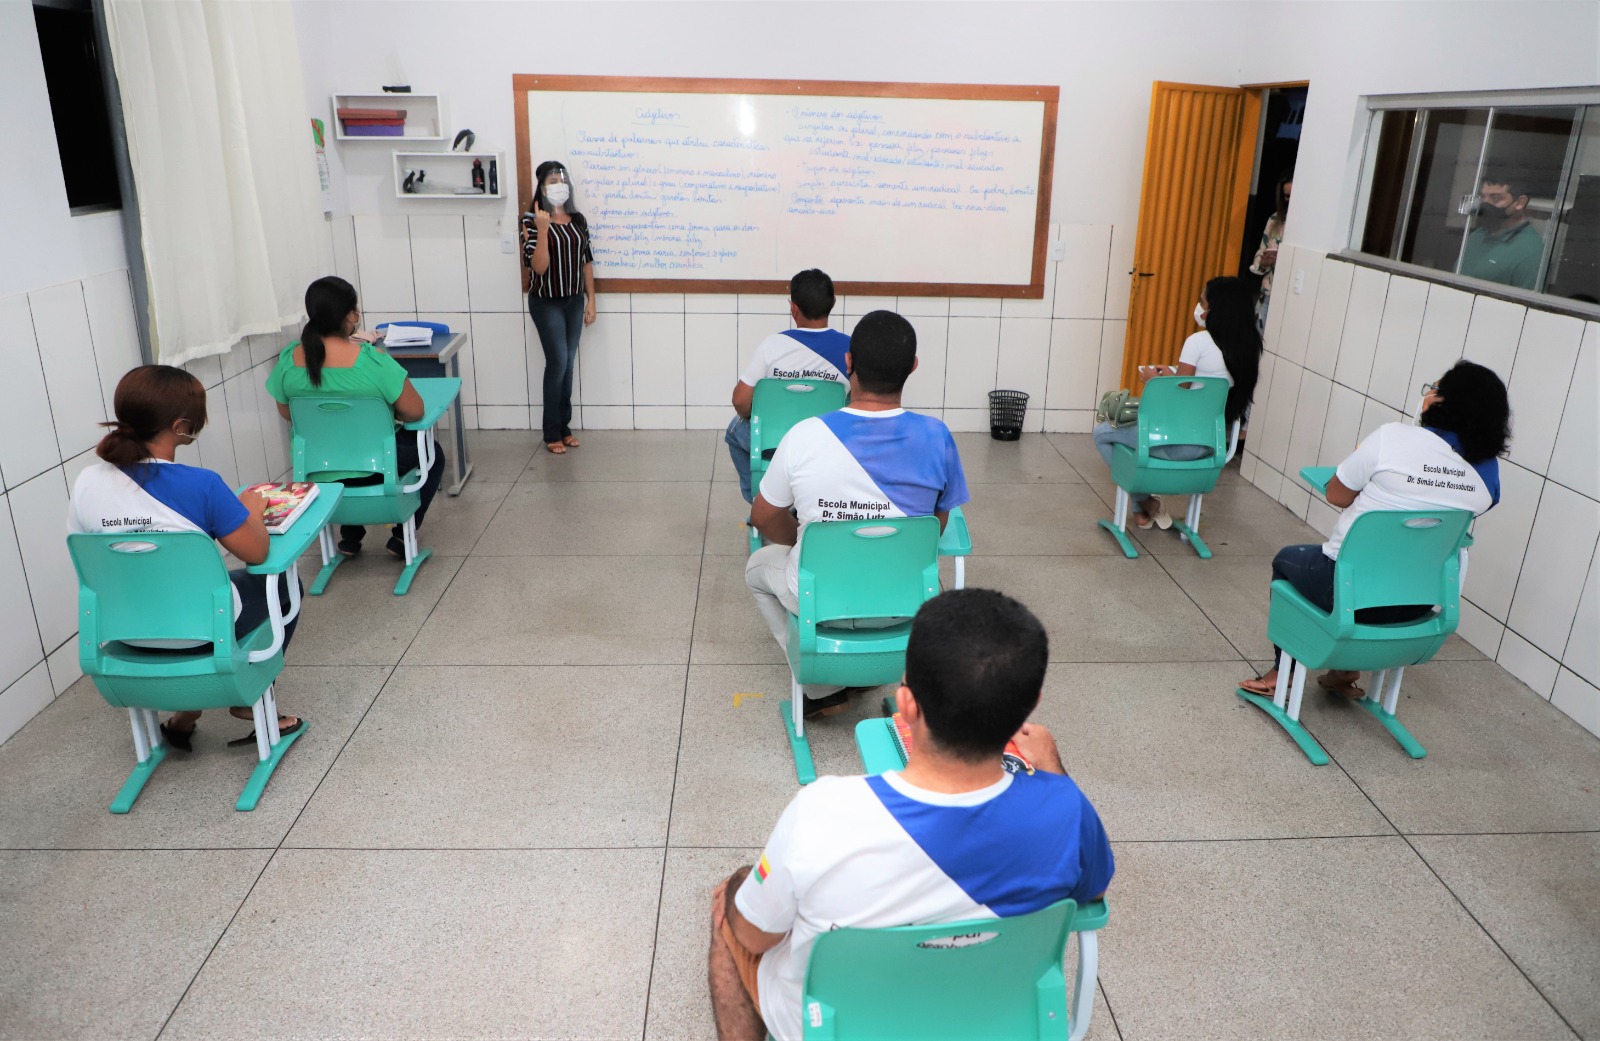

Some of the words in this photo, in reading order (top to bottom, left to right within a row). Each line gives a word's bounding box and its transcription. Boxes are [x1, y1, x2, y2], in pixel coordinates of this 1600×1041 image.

[773, 367, 800, 379] Escola
[801, 369, 839, 381] Municipal
[1423, 464, 1441, 474] Escola
[1442, 466, 1466, 478] Municipal
[1406, 475, 1415, 484] Dr.
[1416, 477, 1434, 487] Simão
[1434, 479, 1446, 488] Lutz
[818, 498, 848, 509] Escola
[849, 501, 891, 512] Municipal
[101, 518, 122, 527] Escola
[123, 516, 152, 527] Municipal
[822, 510, 834, 519] Dr.
[836, 511, 864, 521] Simão
